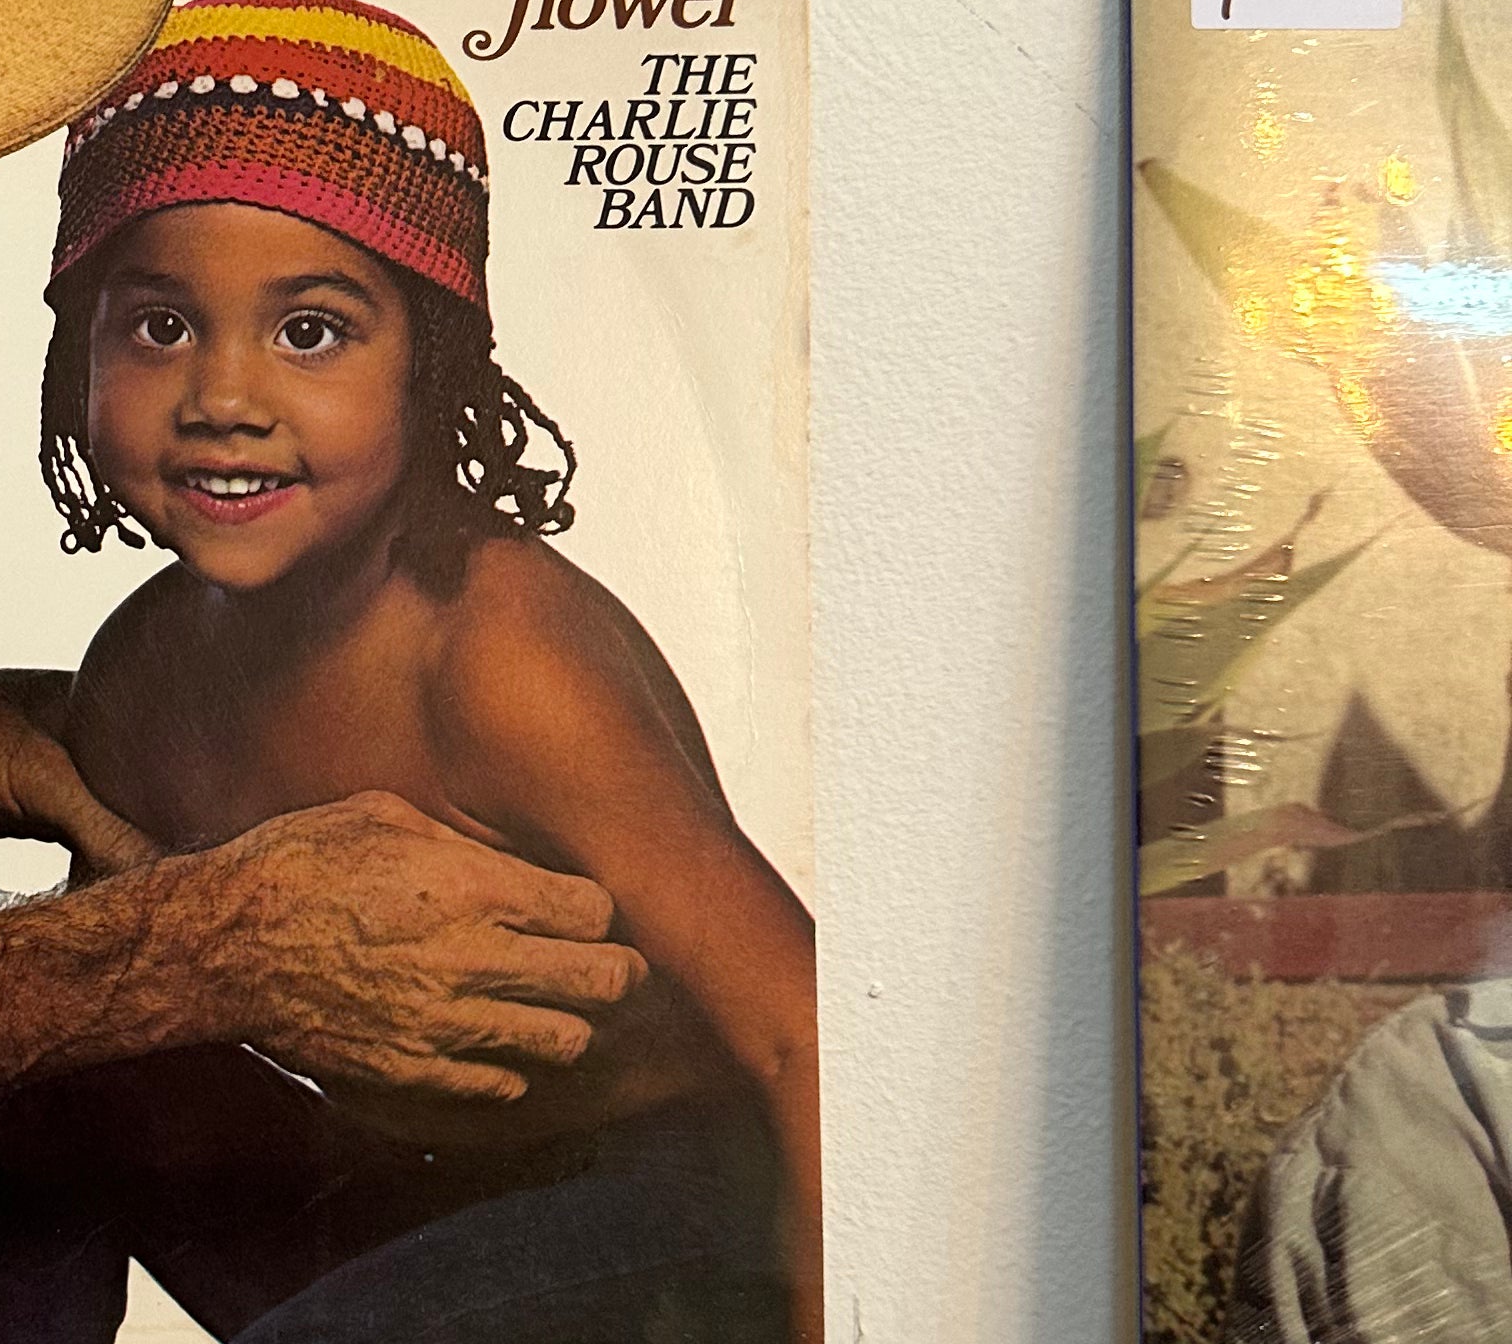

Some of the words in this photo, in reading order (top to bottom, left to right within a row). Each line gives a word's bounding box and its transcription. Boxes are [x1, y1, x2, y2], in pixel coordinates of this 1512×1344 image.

[640, 53, 758, 96] THE
[501, 98, 758, 142] CHARLIE
[564, 142, 757, 186] ROUSE
[593, 187, 756, 230] BAND
